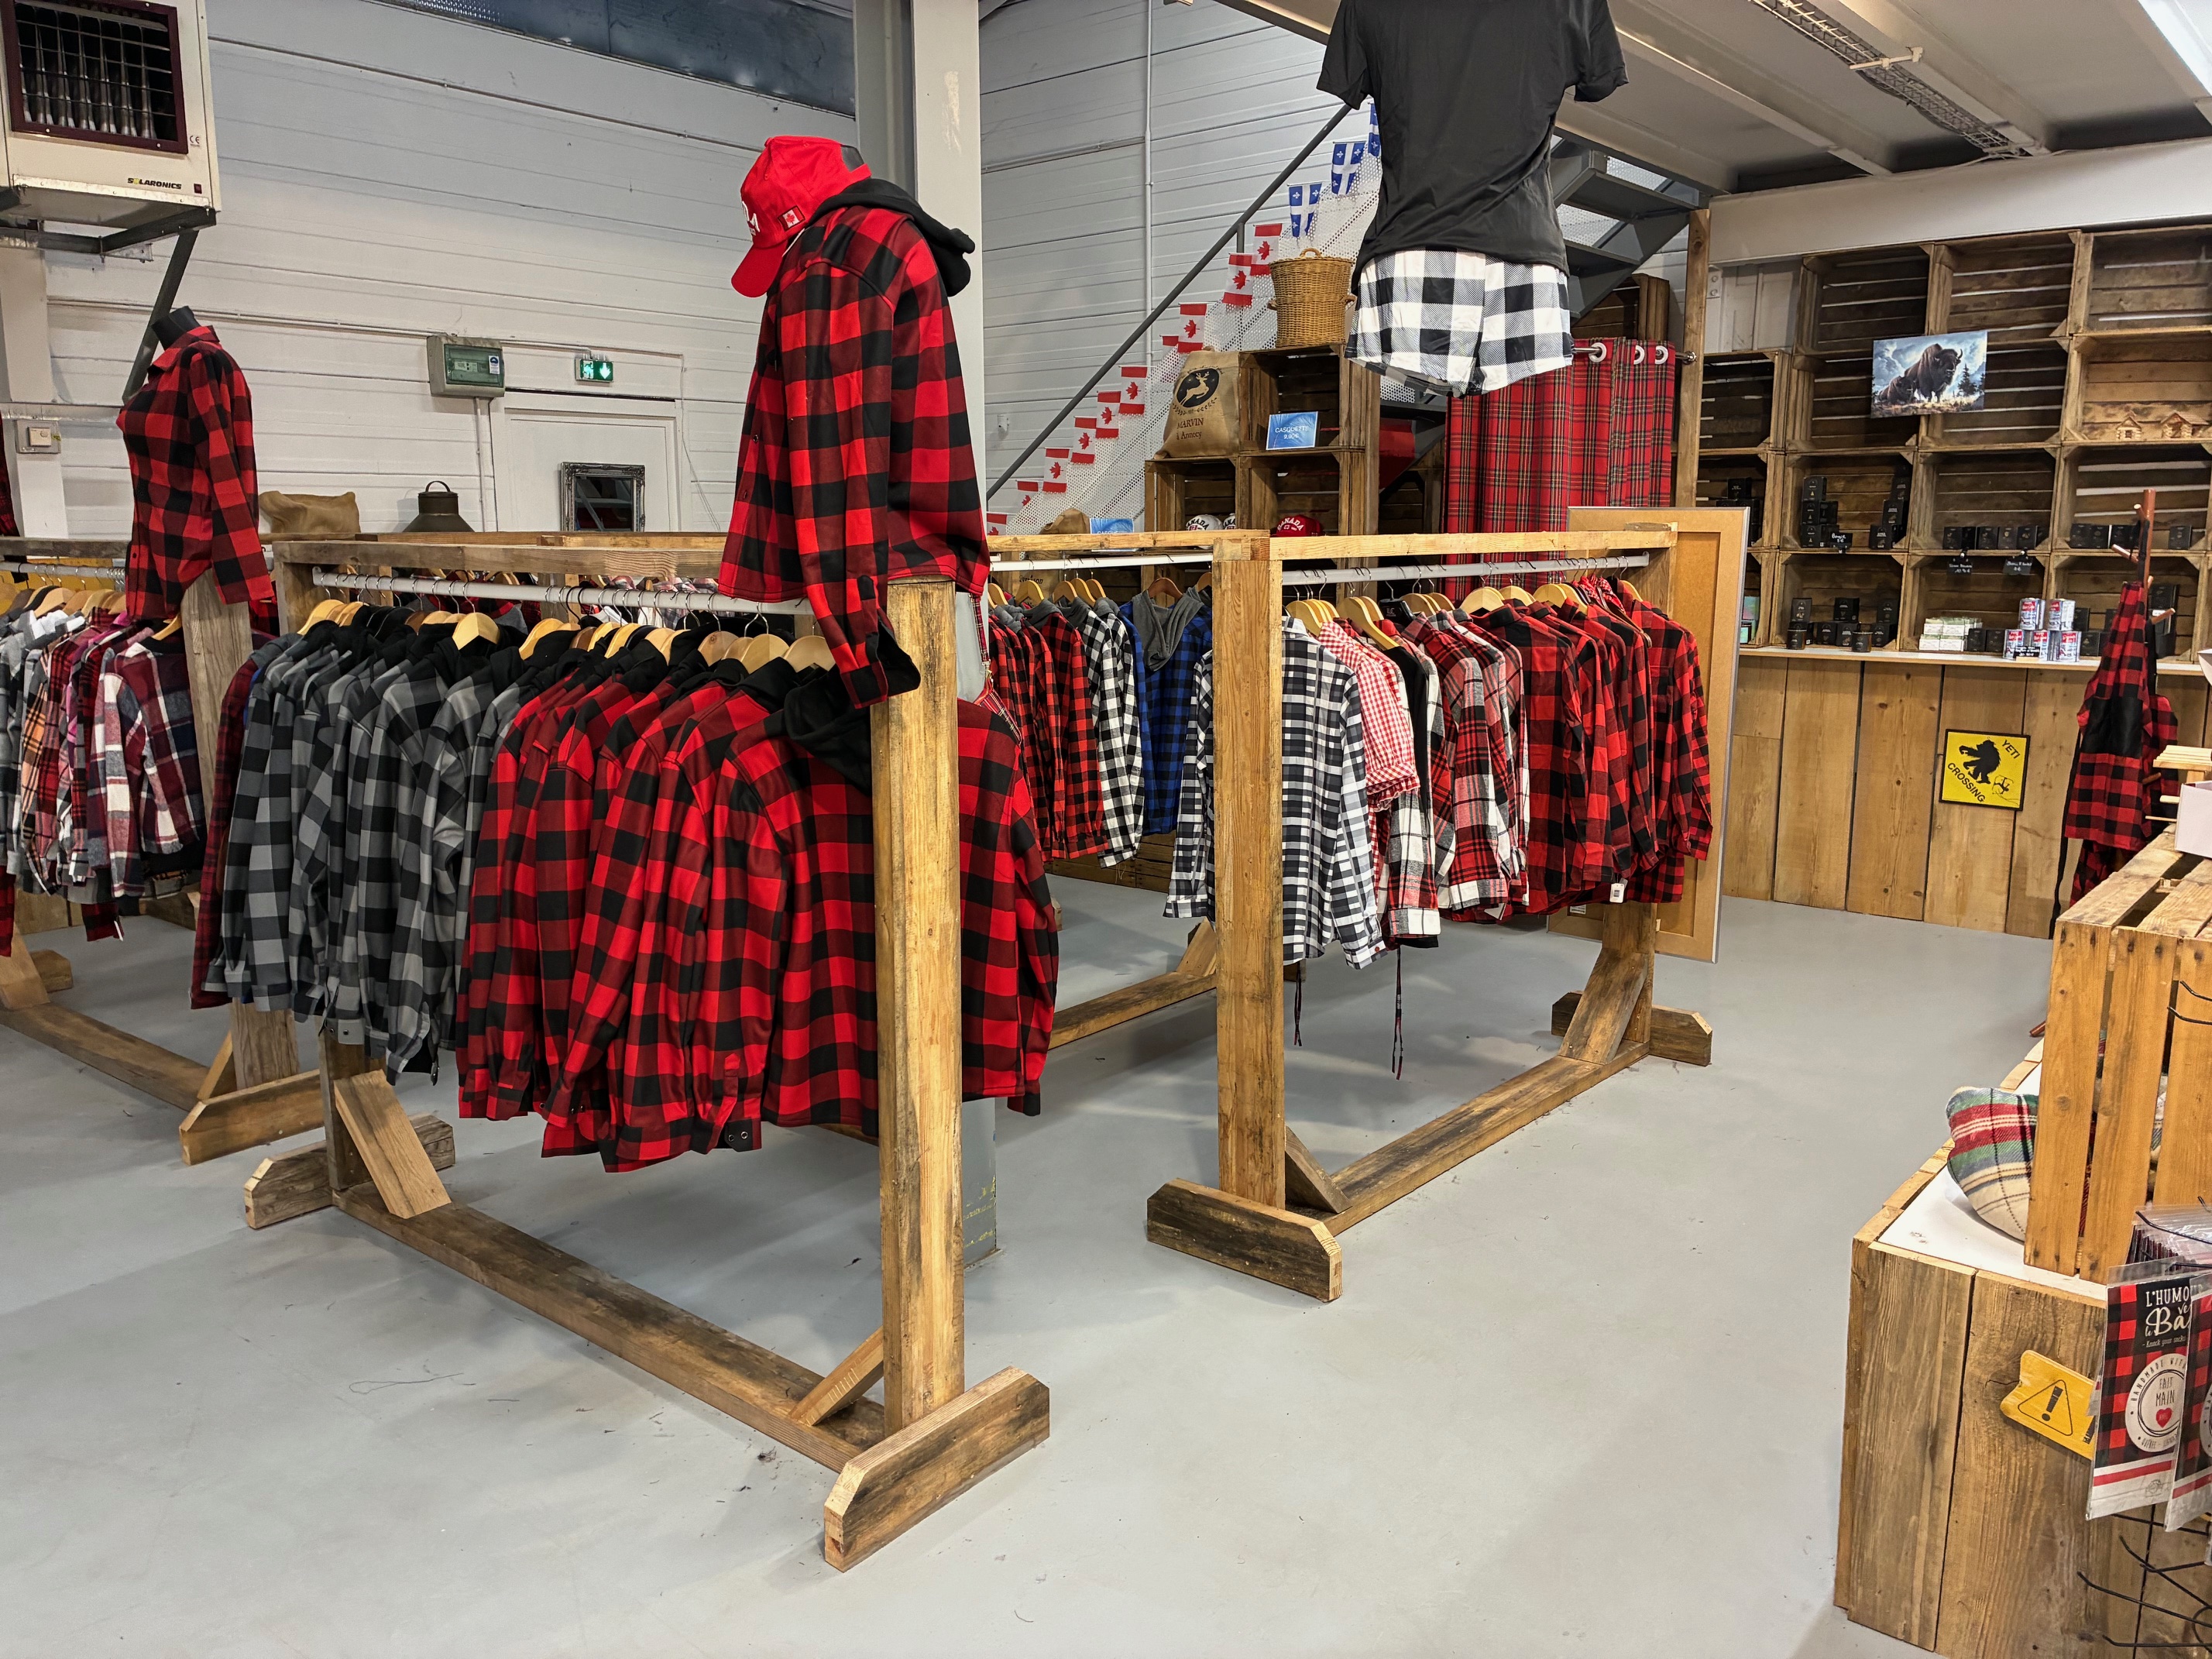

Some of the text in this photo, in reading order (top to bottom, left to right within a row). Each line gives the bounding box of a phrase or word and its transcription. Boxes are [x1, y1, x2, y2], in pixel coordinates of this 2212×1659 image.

[127, 177, 182, 190] SOLARONICS
[1177, 417, 1204, 430] MARVIN
[1275, 425, 1310, 434] CASQUETTE
[1181, 431, 1202, 439] Annecy
[1277, 517, 1304, 531] CANADA
[2001, 740, 2021, 759] YETI
[1947, 762, 1985, 802] CROSSING
[2130, 1359, 2164, 1402] HANDMADE
[2159, 1376, 2174, 1390] FAIT
[2155, 1389, 2175, 1407] MAIN
